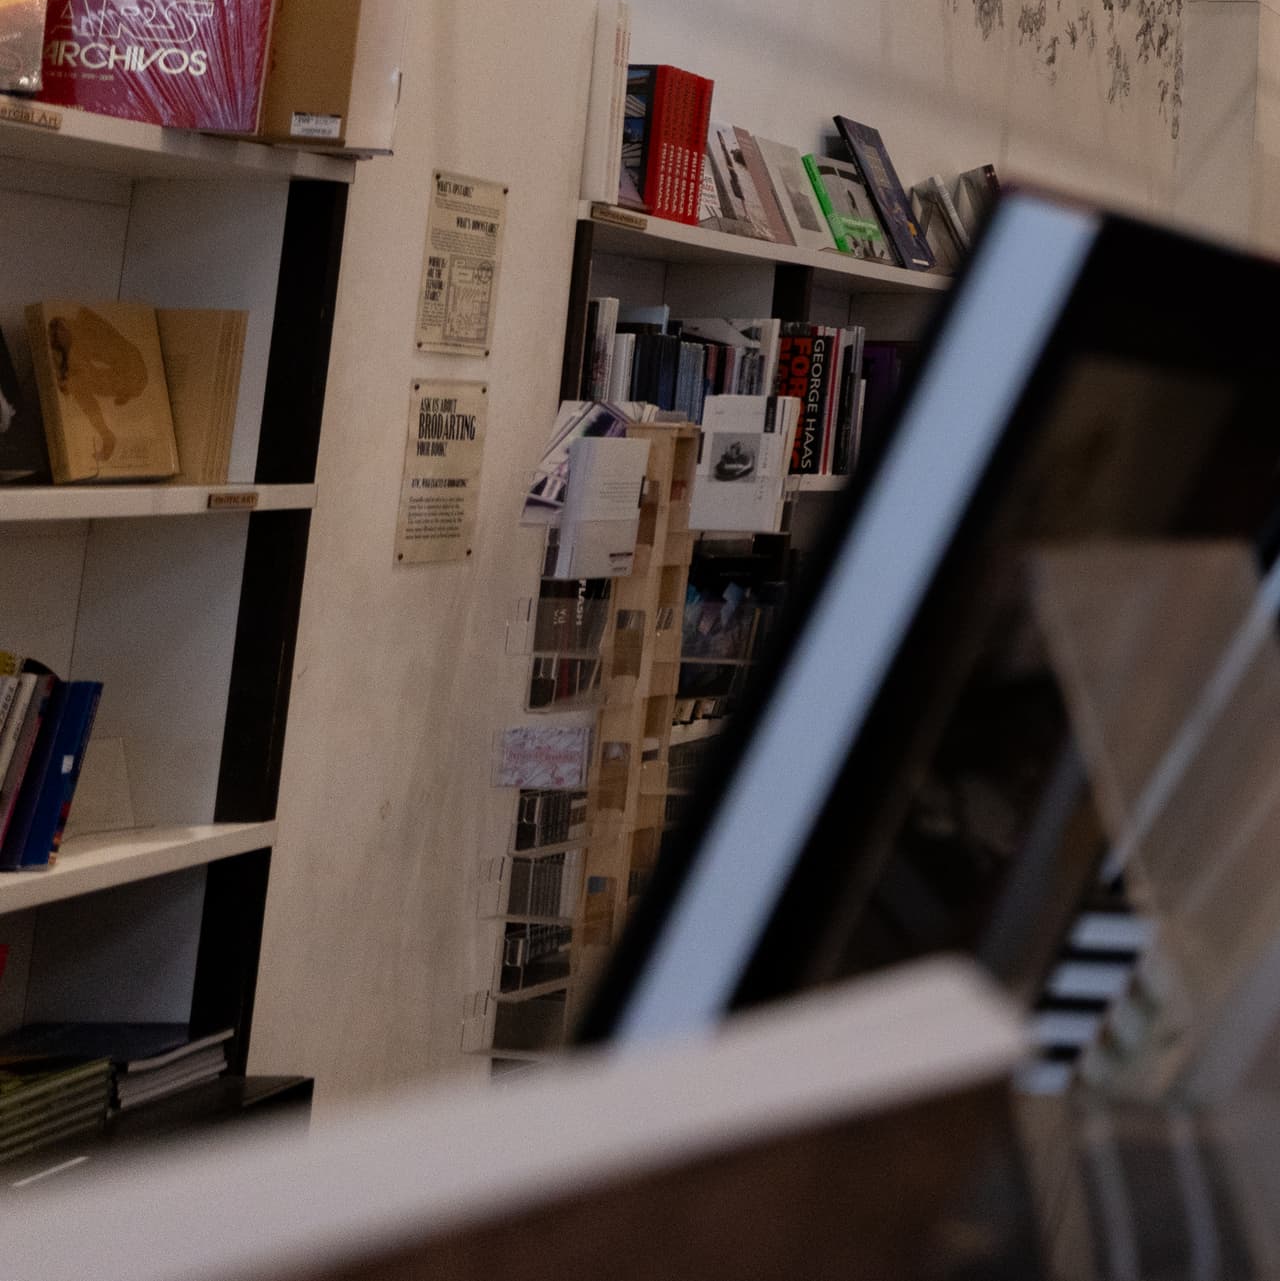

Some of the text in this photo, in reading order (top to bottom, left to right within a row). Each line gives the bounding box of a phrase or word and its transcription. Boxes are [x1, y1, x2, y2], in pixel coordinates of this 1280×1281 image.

[421, 397, 458, 413] ASK US ABOUT
[801, 339, 826, 470] GEORGE HAAS
[418, 412, 476, 441] BRODARTING
